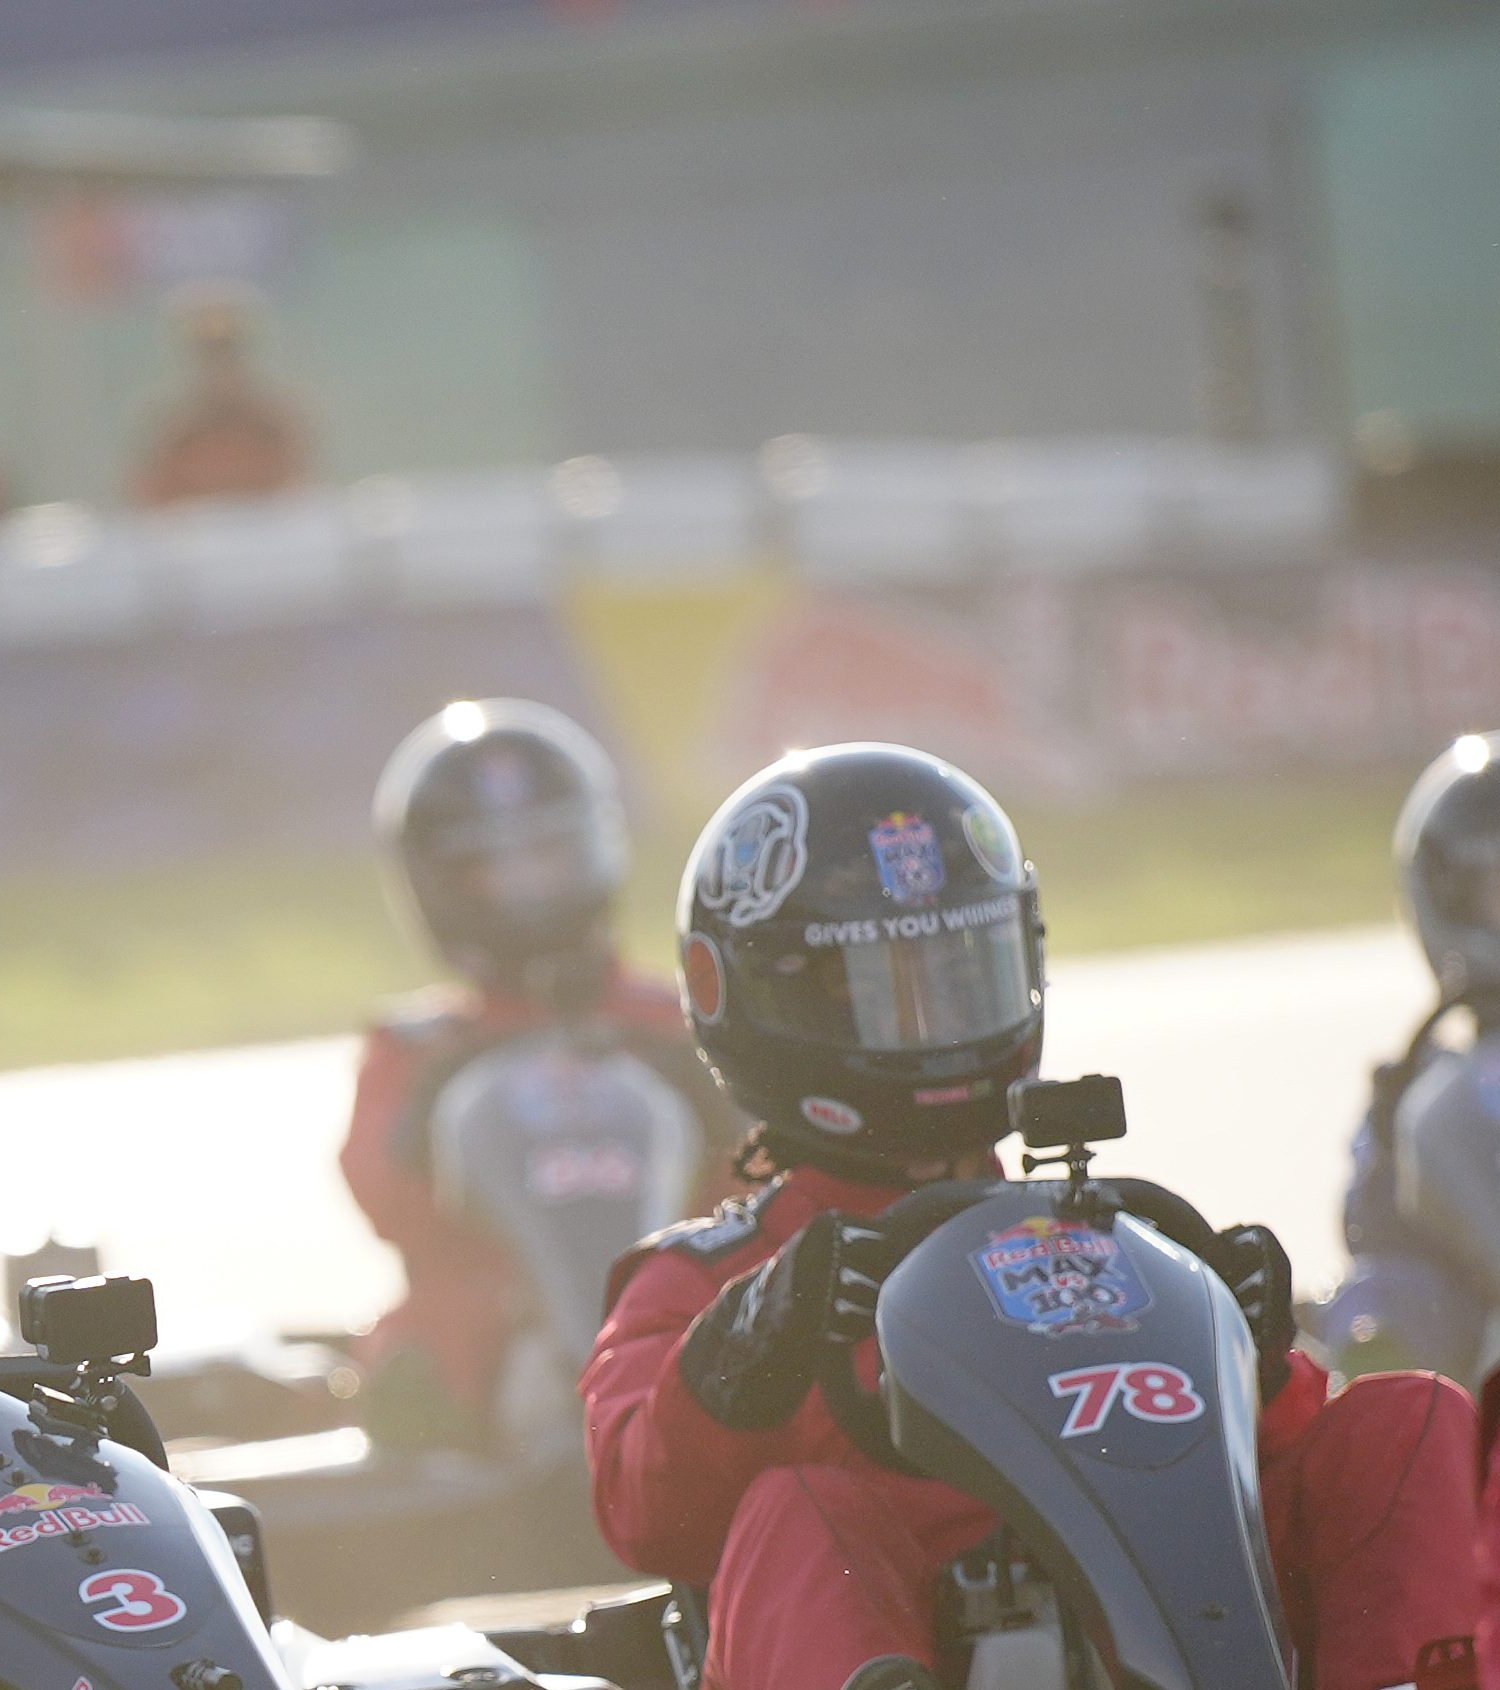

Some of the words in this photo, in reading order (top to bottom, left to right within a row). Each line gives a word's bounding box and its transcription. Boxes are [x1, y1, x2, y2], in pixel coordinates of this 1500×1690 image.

[804, 919, 879, 946] GIVES
[882, 911, 940, 938] YOU
[1047, 1362, 1206, 1438] 78
[60, 1502, 152, 1532] Bull
[79, 1569, 187, 1633] 3
